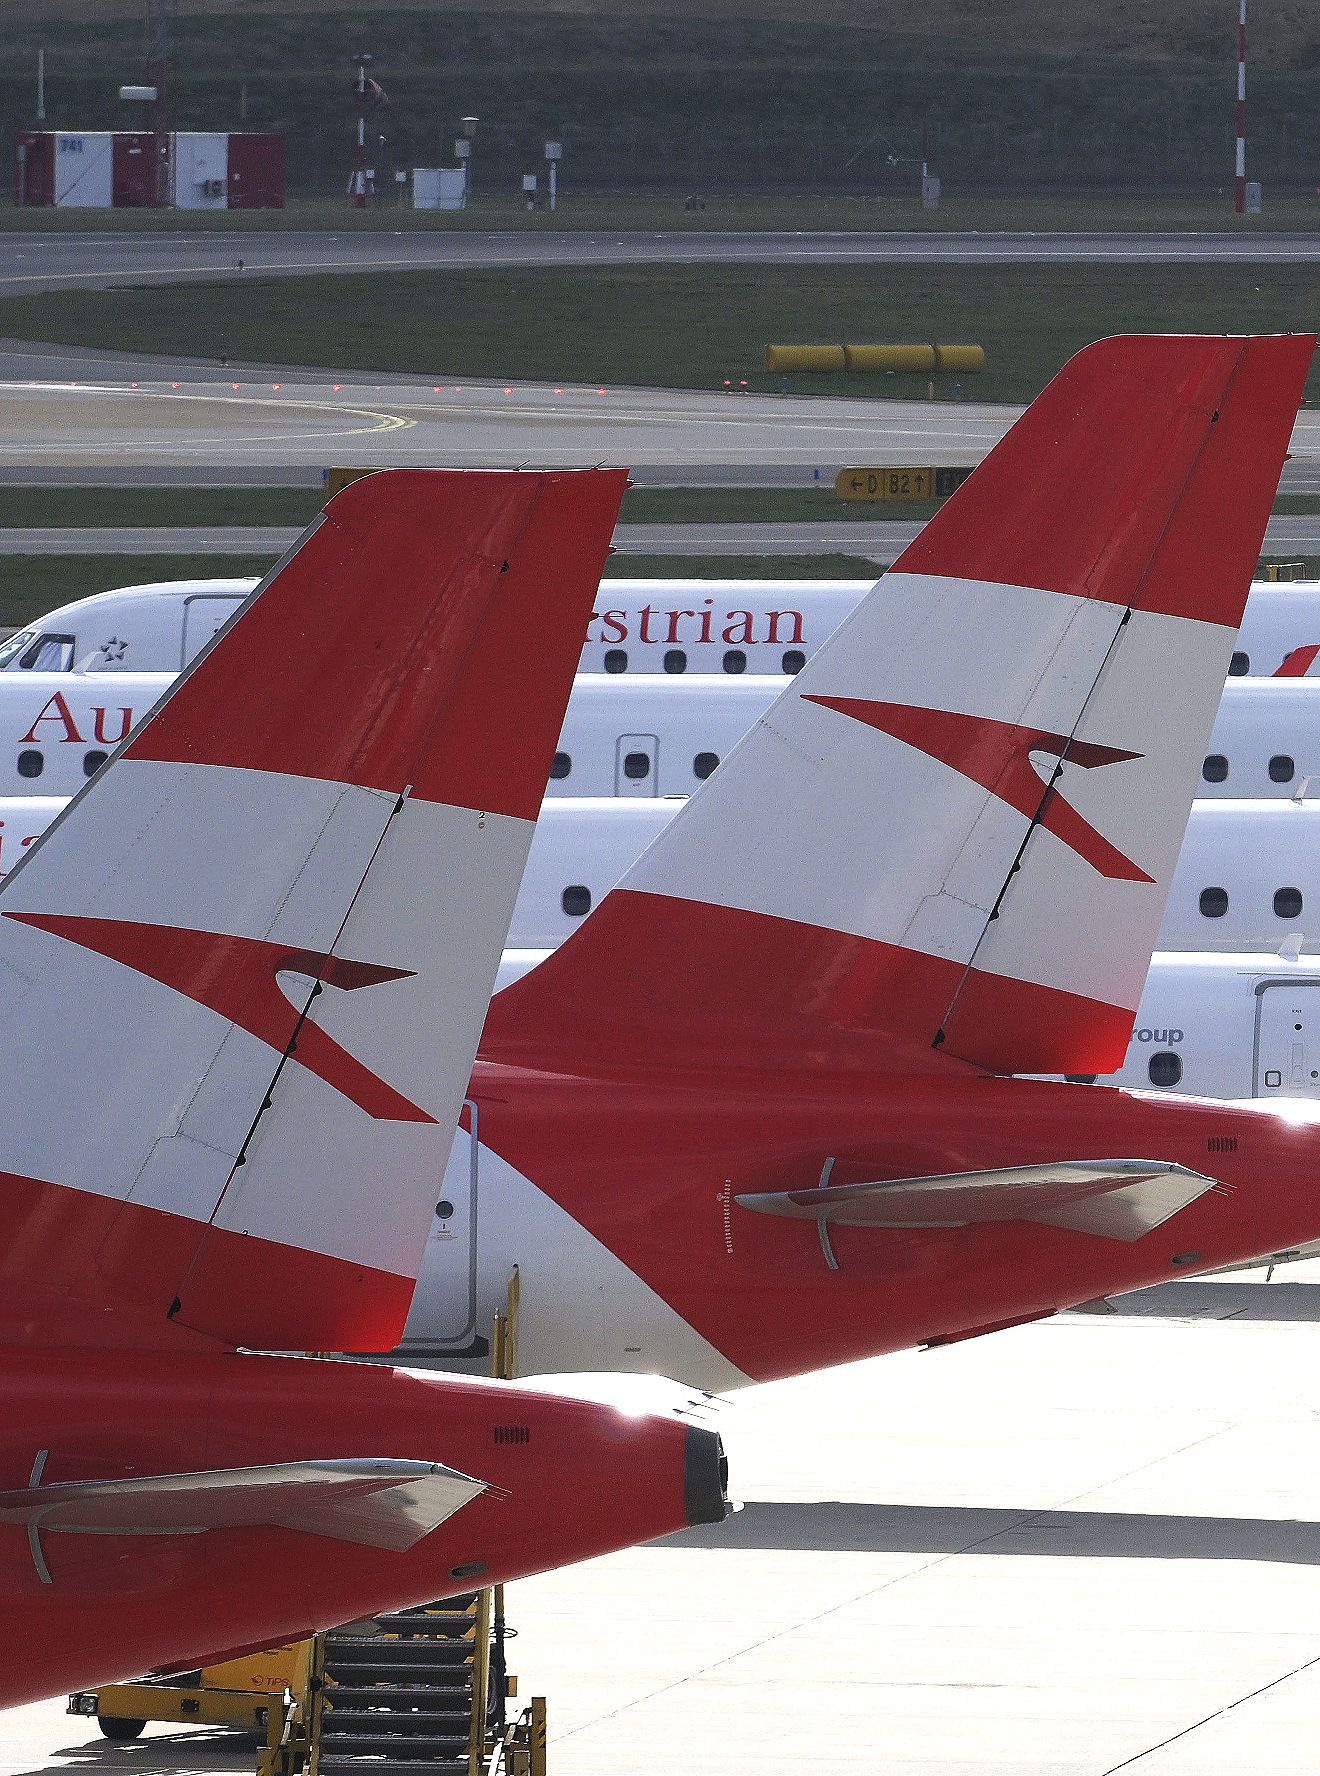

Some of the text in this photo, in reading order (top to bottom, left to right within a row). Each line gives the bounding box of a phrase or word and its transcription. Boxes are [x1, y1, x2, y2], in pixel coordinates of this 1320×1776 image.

[867, 475, 878, 493] D
[890, 474, 909, 493] B2
[587, 599, 807, 644] strian
[18, 691, 133, 744] Au
